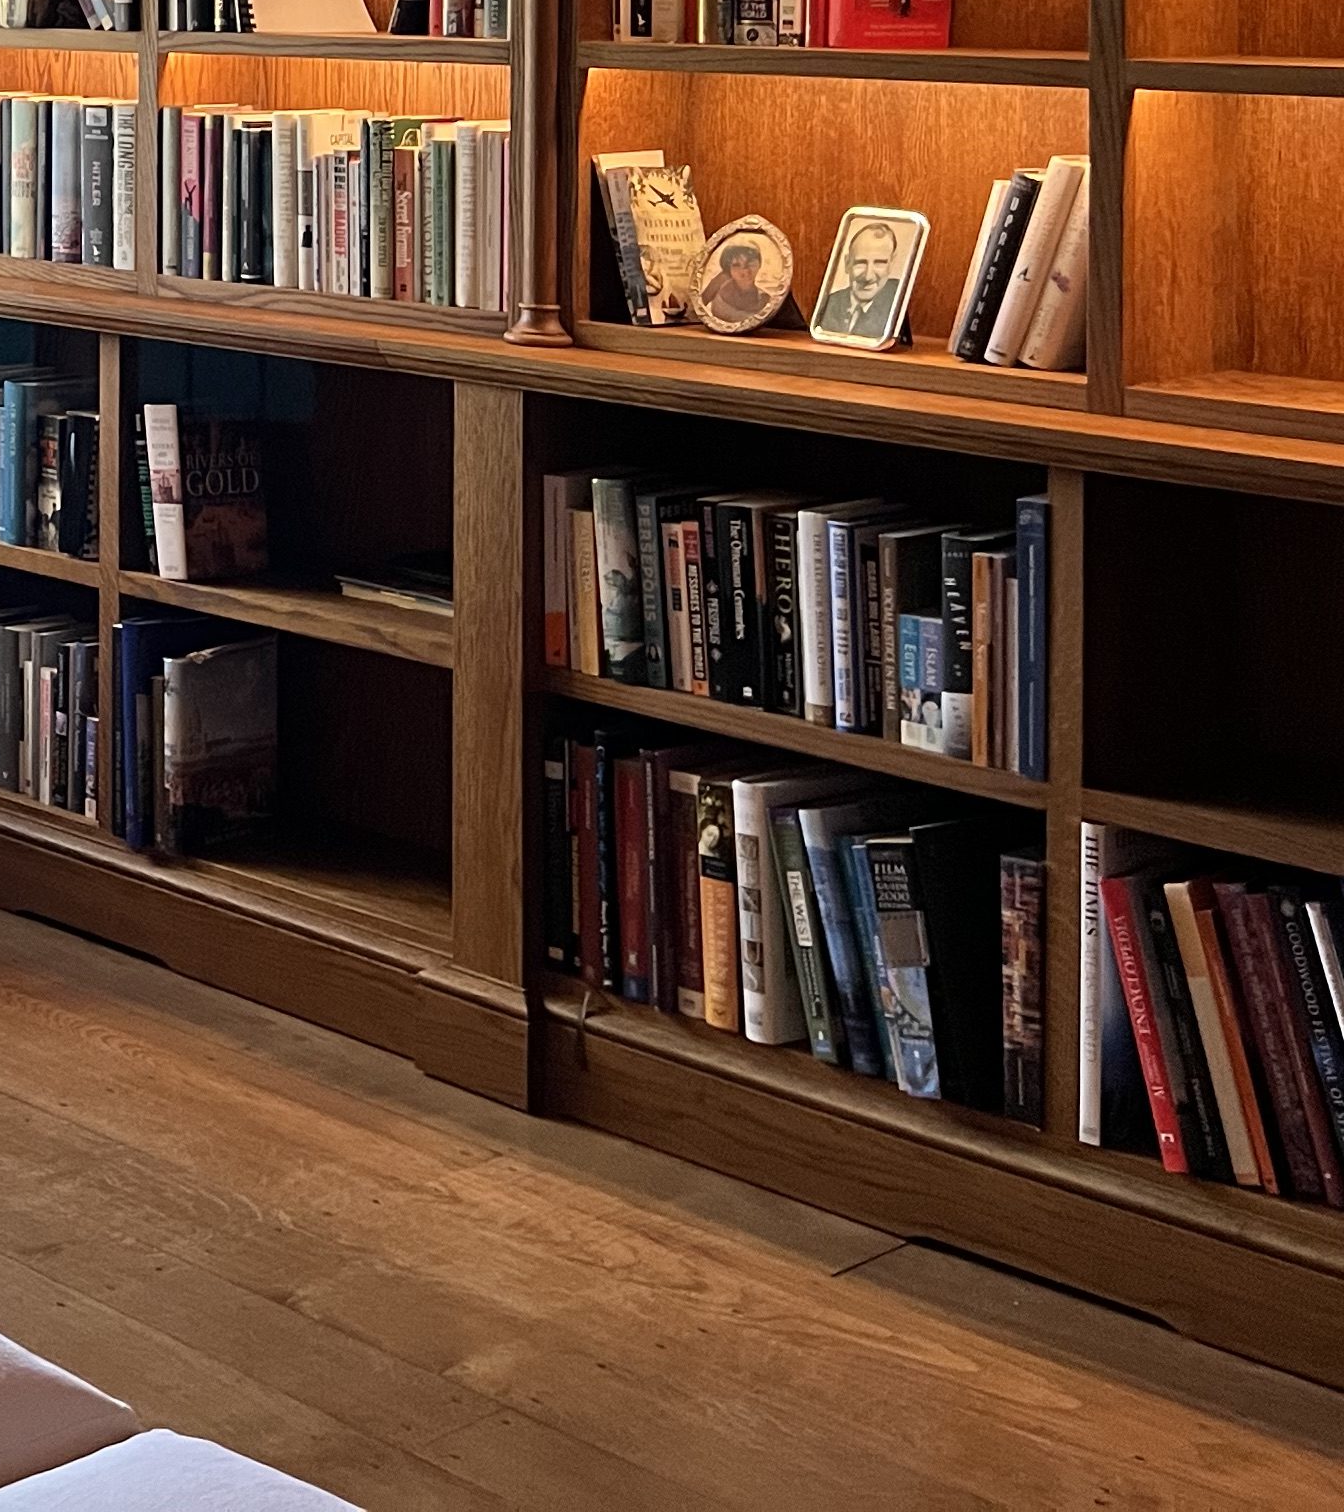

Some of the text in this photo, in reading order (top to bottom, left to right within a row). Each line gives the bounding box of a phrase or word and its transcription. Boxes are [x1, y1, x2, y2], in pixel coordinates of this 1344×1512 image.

[117, 113, 134, 130] THE
[117, 134, 134, 169] LONG
[92, 161, 101, 206] HITLER
[334, 209, 346, 256] MADOFF
[396, 189, 412, 267] Secret Formula
[963, 194, 1020, 334] UPRISING
[186, 451, 256, 469] RIVERS OF
[186, 467, 260, 496] GOLD
[637, 504, 657, 622] PERSEPOLIS
[729, 520, 746, 640] The Ottoman Centuries
[773, 533, 794, 614] HERO
[867, 560, 877, 599] OSAMA
[687, 564, 705, 679] MESSAGES TO THE WORLD
[707, 598, 720, 645] PERSEPOLIS
[813, 533, 830, 687] THE BALFOUR DECLARATION
[869, 622, 880, 657] LADEN
[944, 577, 972, 651] HEAVEN
[882, 586, 896, 710] SOCIAL JUSTICE IN ISLAM
[904, 643, 918, 682] EGYPT
[926, 647, 938, 687] ISLAM
[787, 874, 810, 944] THE WEST
[1084, 834, 1099, 937] THE TIMES
[1113, 914, 1151, 1035] ENCYCLOPEDIA
[1285, 921, 1342, 1108] GOODWOOD FESTIVAL OF
